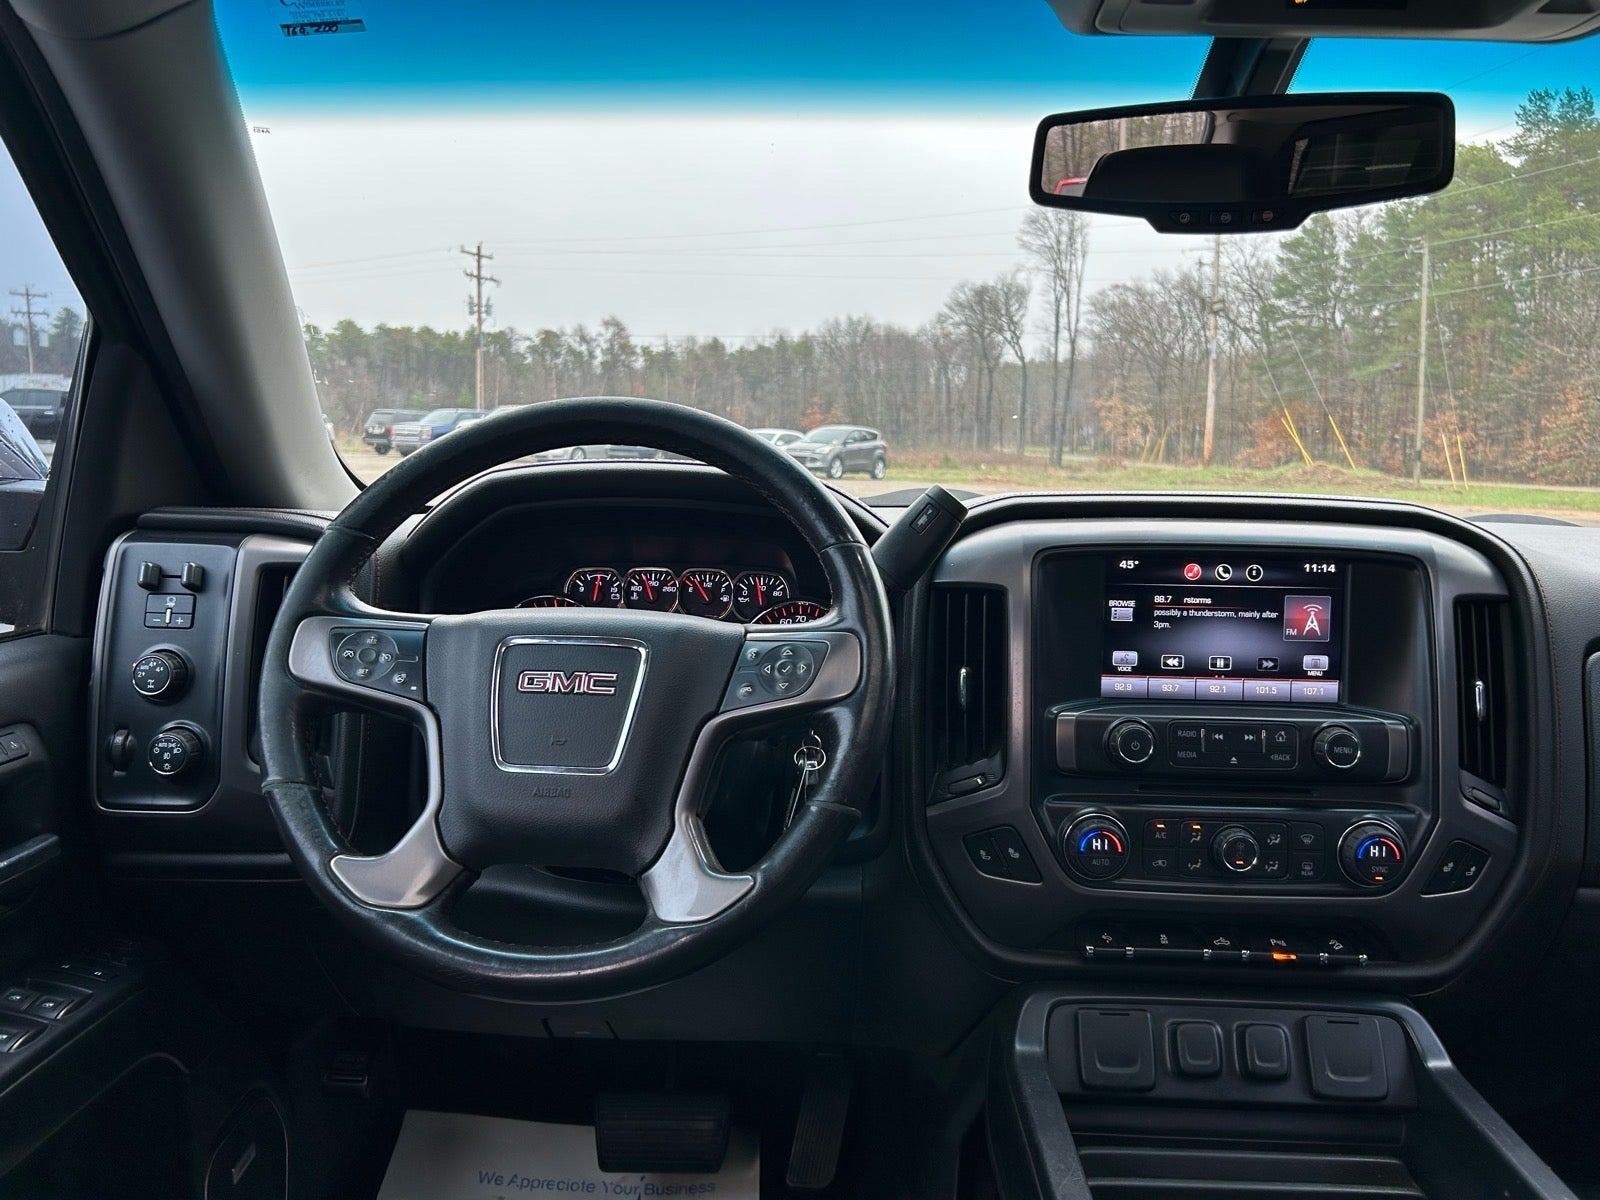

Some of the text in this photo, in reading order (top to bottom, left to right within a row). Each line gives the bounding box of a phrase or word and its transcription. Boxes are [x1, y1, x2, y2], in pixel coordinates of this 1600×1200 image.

[1303, 563, 1336, 573] 11:14
[1154, 595, 1212, 604] 88.7 rstorms
[1153, 608, 1181, 618] possibly
[1188, 608, 1237, 619] thunderstorm,
[1238, 610, 1260, 620] mainly
[1261, 610, 1279, 618] after
[795, 615, 807, 623] 70
[1153, 620, 1172, 630] 3pm.
[1285, 628, 1297, 636] FM
[518, 670, 618, 694] GMC
[1114, 683, 1132, 692] 92.9
[1161, 684, 1180, 693] 93.7
[1209, 685, 1227, 693] 92.1
[1255, 686, 1277, 694] 101.5
[1303, 687, 1324, 696] 107.1
[1177, 729, 1197, 738] RADIO
[1177, 750, 1197, 759] MEDIA
[1333, 746, 1353, 755] MENU
[532, 786, 571, 798] AIRBAG
[1155, 831, 1167, 839] A/C
[1092, 838, 1109, 851] HI
[1370, 845, 1387, 857] HI
[1091, 857, 1110, 866] AUTO
[1371, 865, 1389, 874] SYNC
[478, 1170, 504, 1186] We
[643, 1182, 716, 1196] Business
